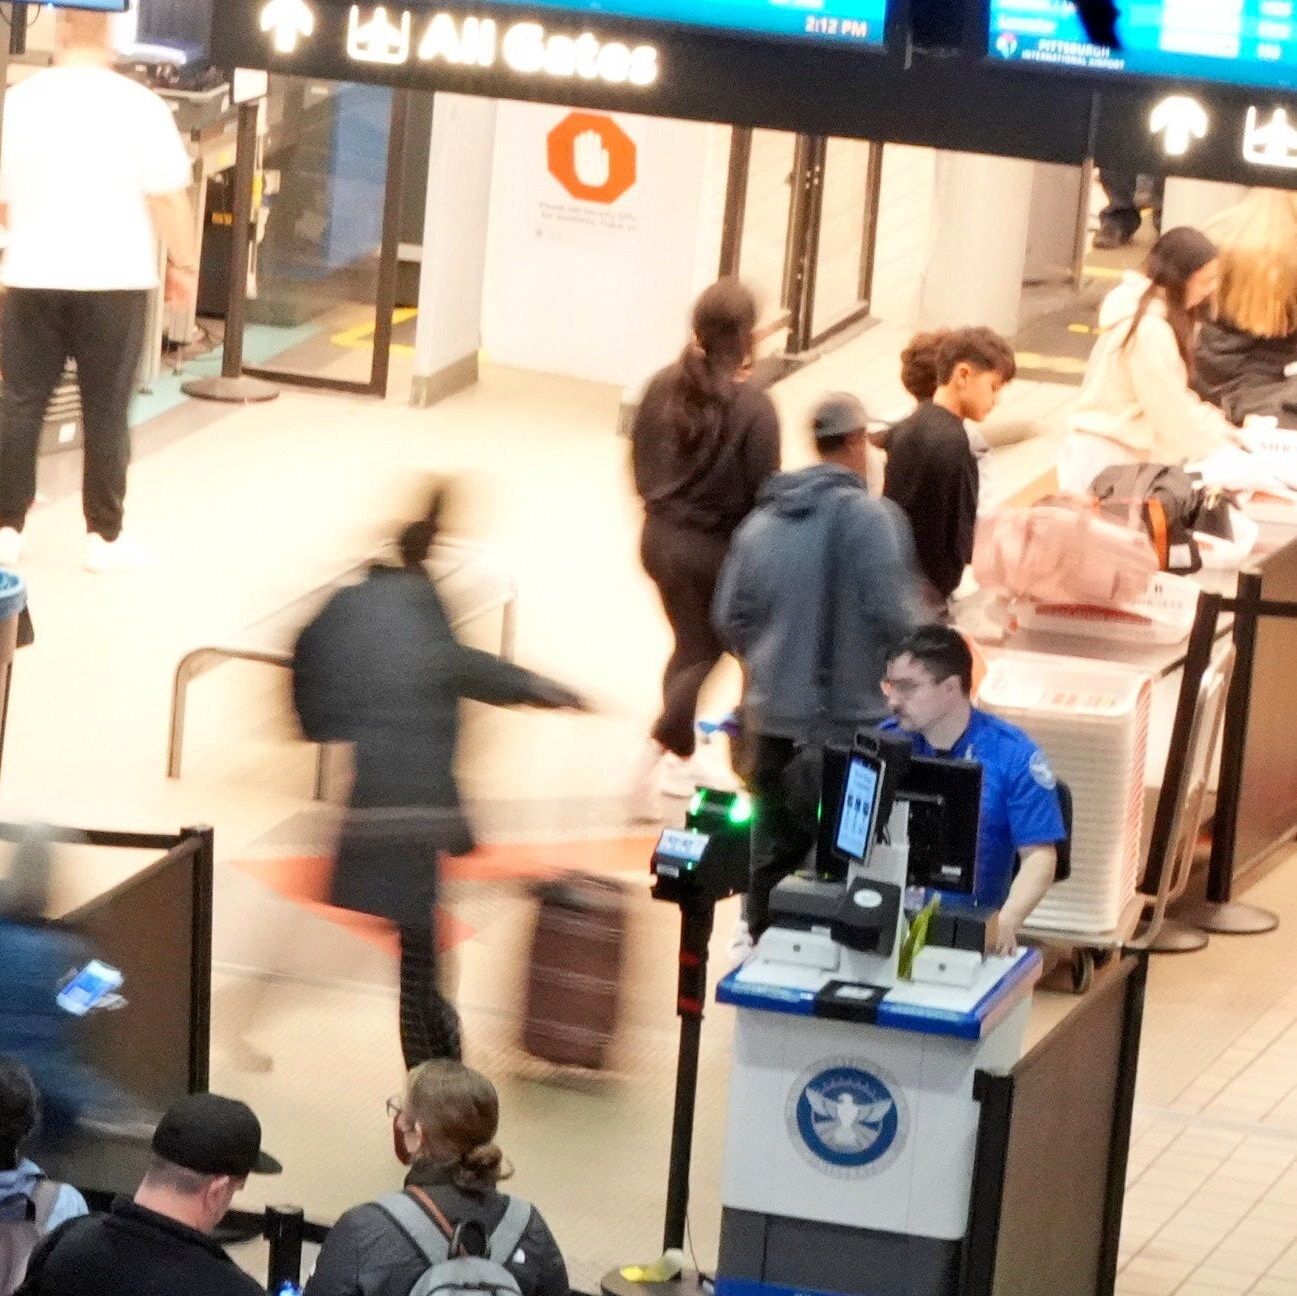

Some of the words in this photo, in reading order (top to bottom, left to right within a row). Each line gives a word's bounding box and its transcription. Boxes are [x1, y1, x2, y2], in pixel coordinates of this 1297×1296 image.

[842, 20, 867, 37] PM
[418, 12, 496, 67] All
[504, 22, 657, 85] Gates
[1039, 39, 1110, 57] PITTSBURGH
[1022, 49, 1087, 66] INTERNATIONAL
[1089, 57, 1124, 70] AIRPORT
